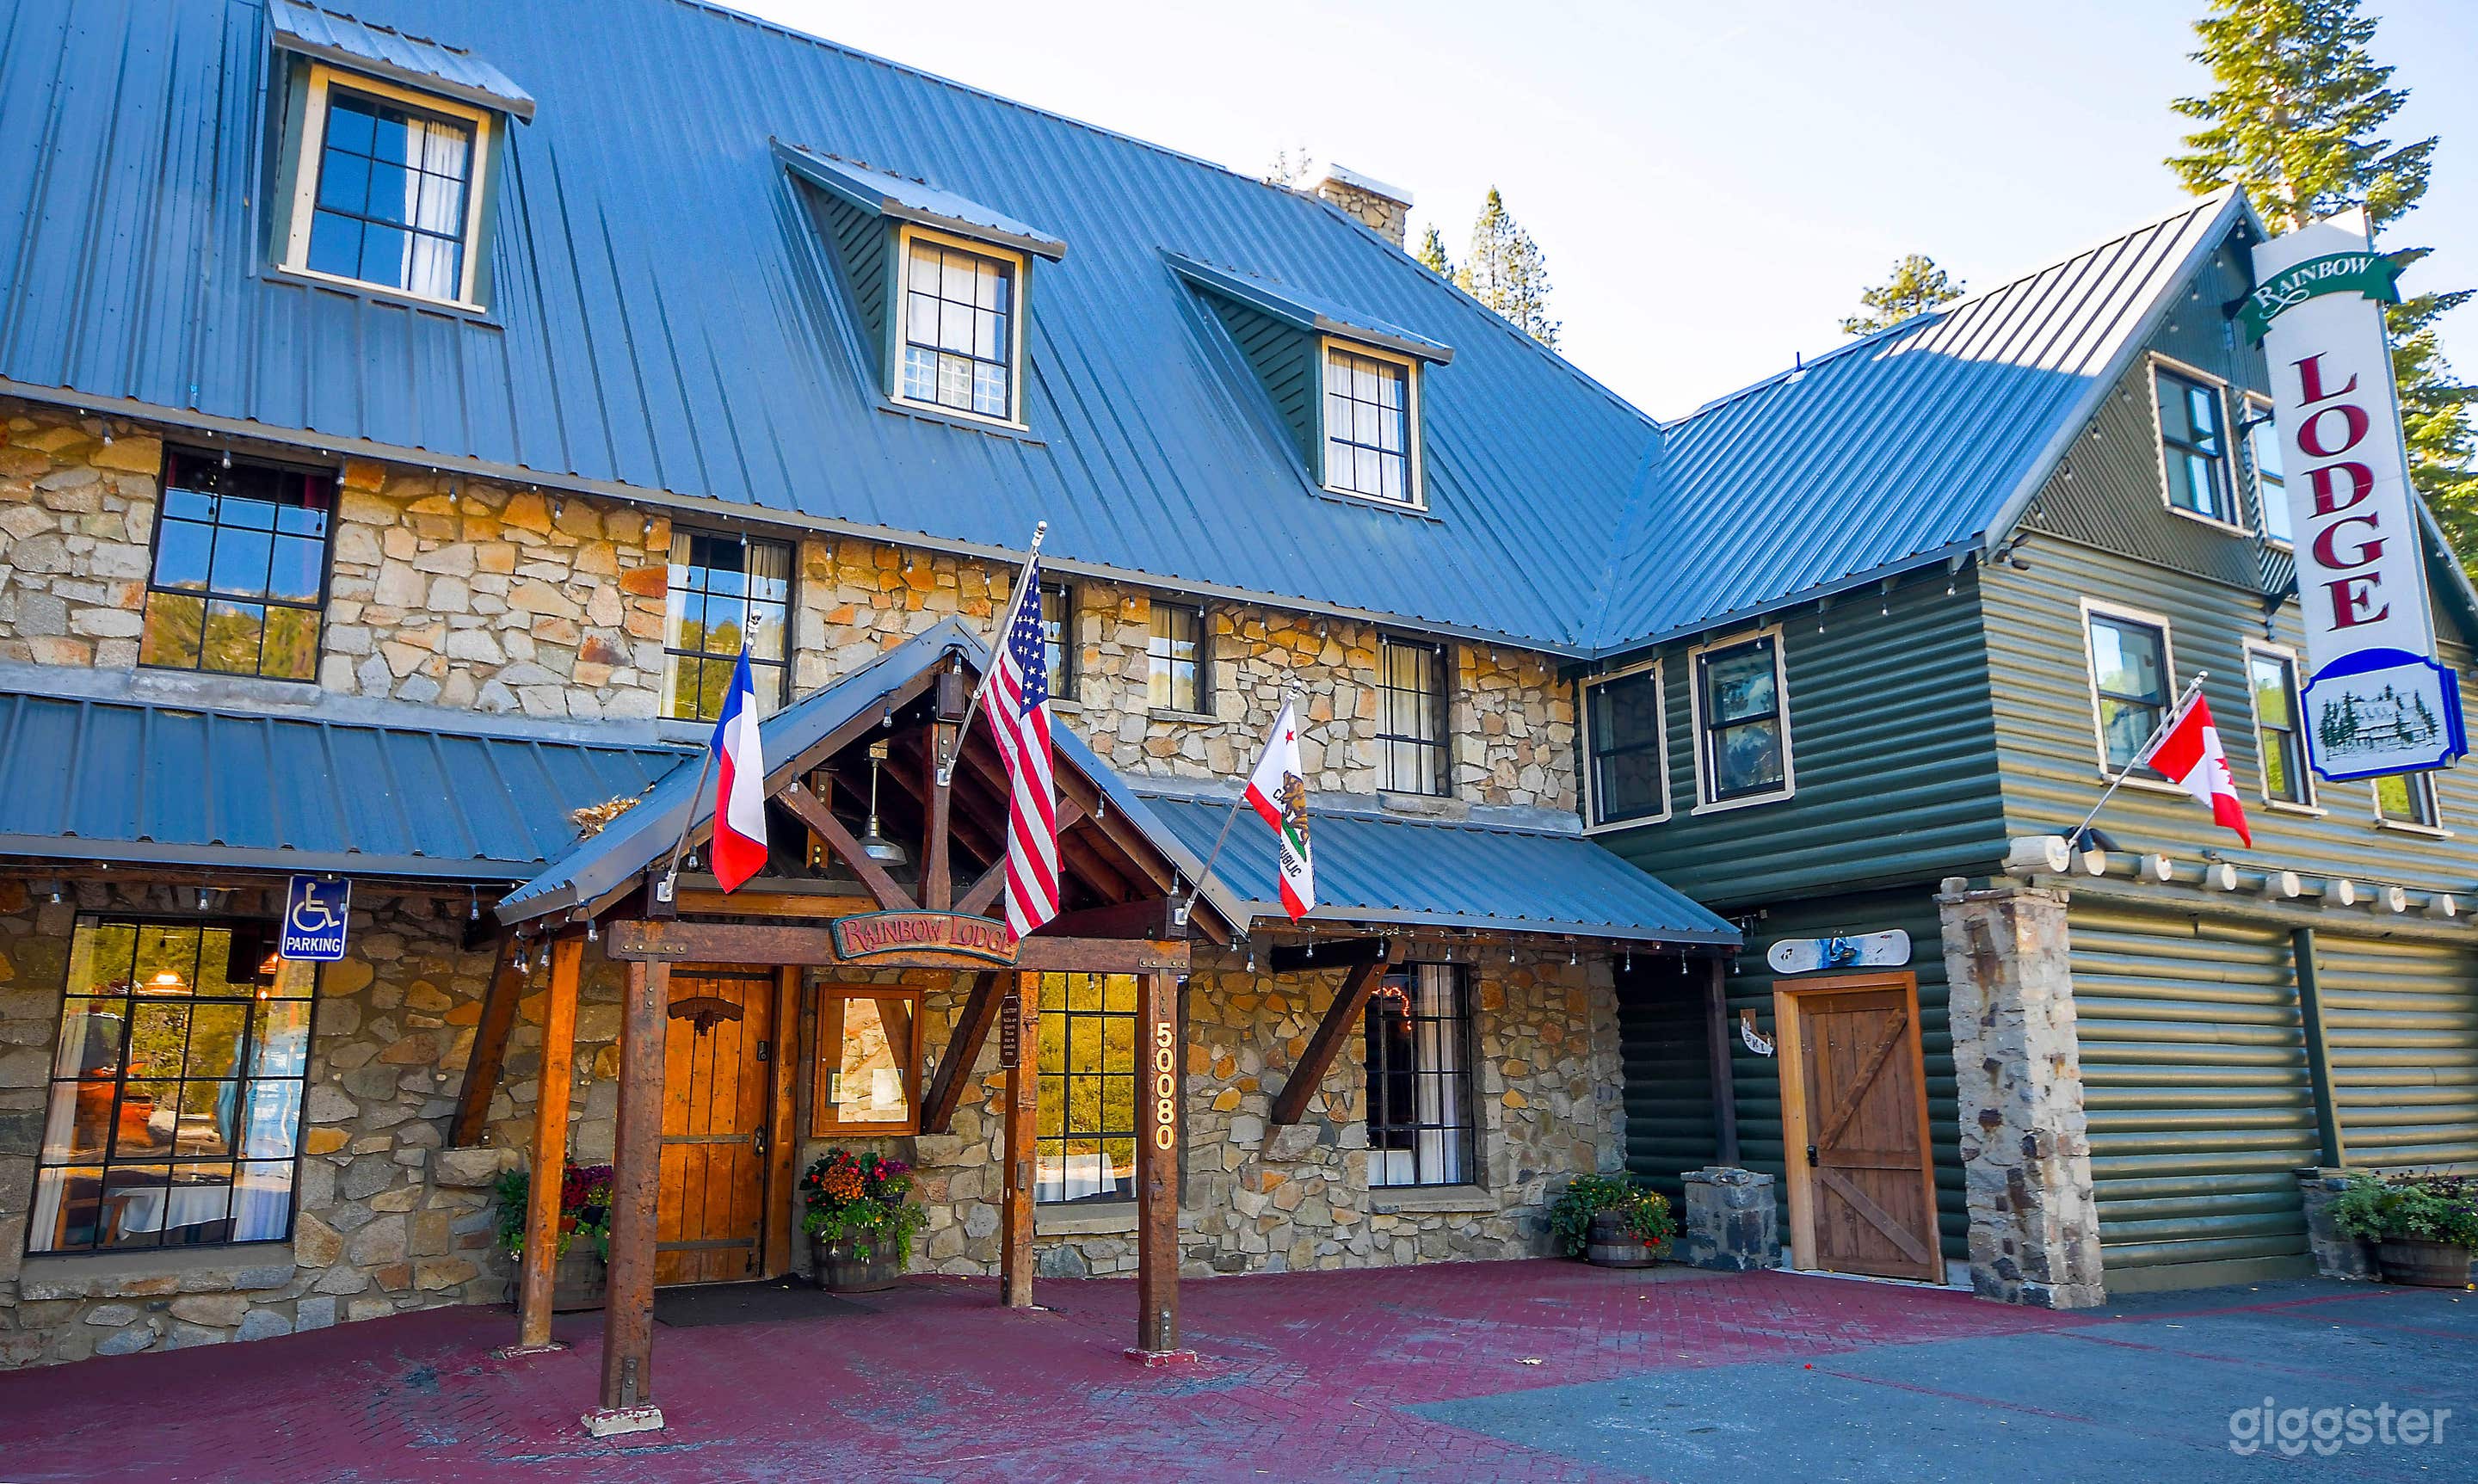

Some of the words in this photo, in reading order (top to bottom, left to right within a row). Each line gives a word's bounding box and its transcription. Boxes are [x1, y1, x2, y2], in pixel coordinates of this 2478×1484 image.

[2252, 256, 2375, 319] RAINBOW
[2290, 351, 2389, 633] LODGE
[1279, 839, 1302, 877] PUBLIC
[286, 936, 341, 952] PARKING
[841, 919, 945, 952] RAINBOW
[1745, 1033, 1765, 1052] SKI
[1155, 1022, 1174, 1150] 50080
